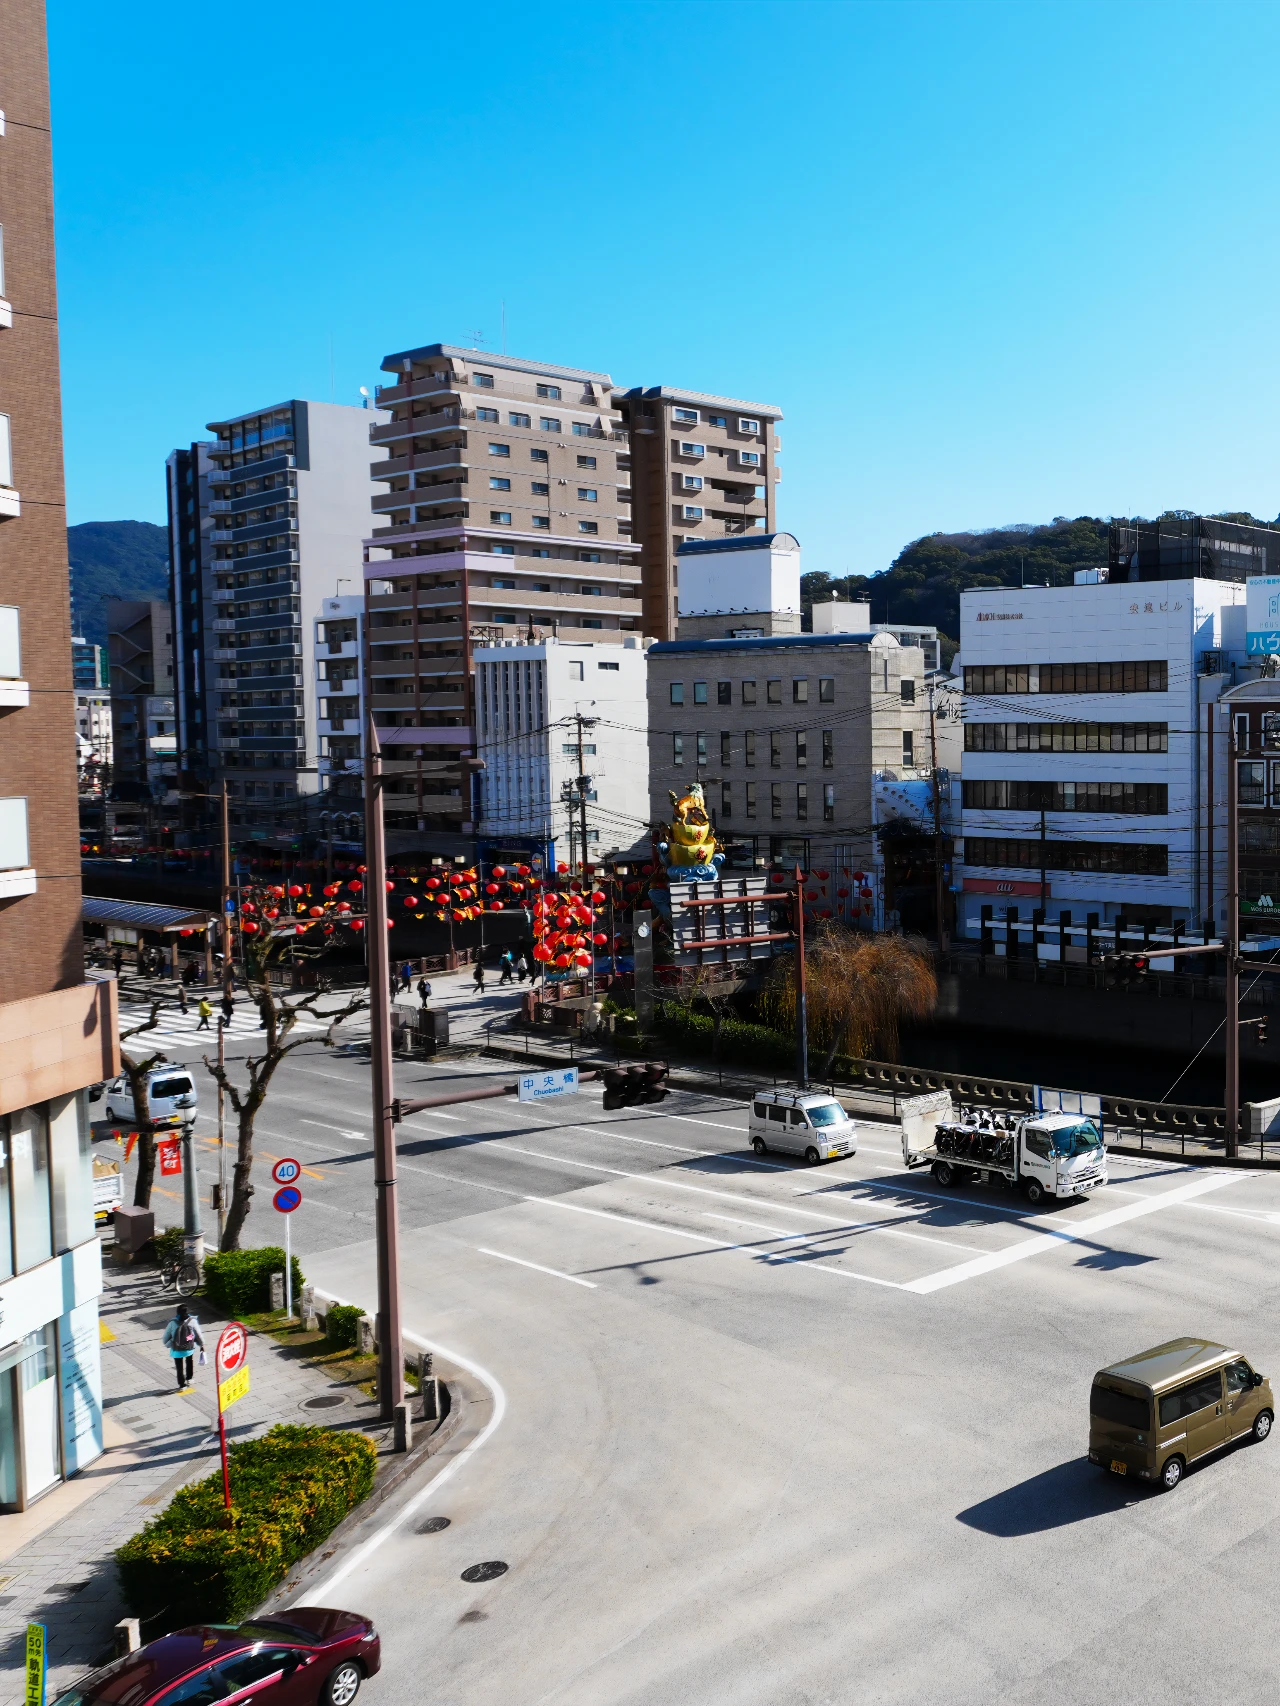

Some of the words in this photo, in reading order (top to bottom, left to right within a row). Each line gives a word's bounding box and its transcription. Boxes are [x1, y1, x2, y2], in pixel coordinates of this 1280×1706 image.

[996, 882, 1015, 893] au
[523, 1072, 574, 1090] 中央橋
[533, 1086, 564, 1096] Chuobashi
[278, 1165, 295, 1178] 40
[29, 1637, 42, 1648] 50
